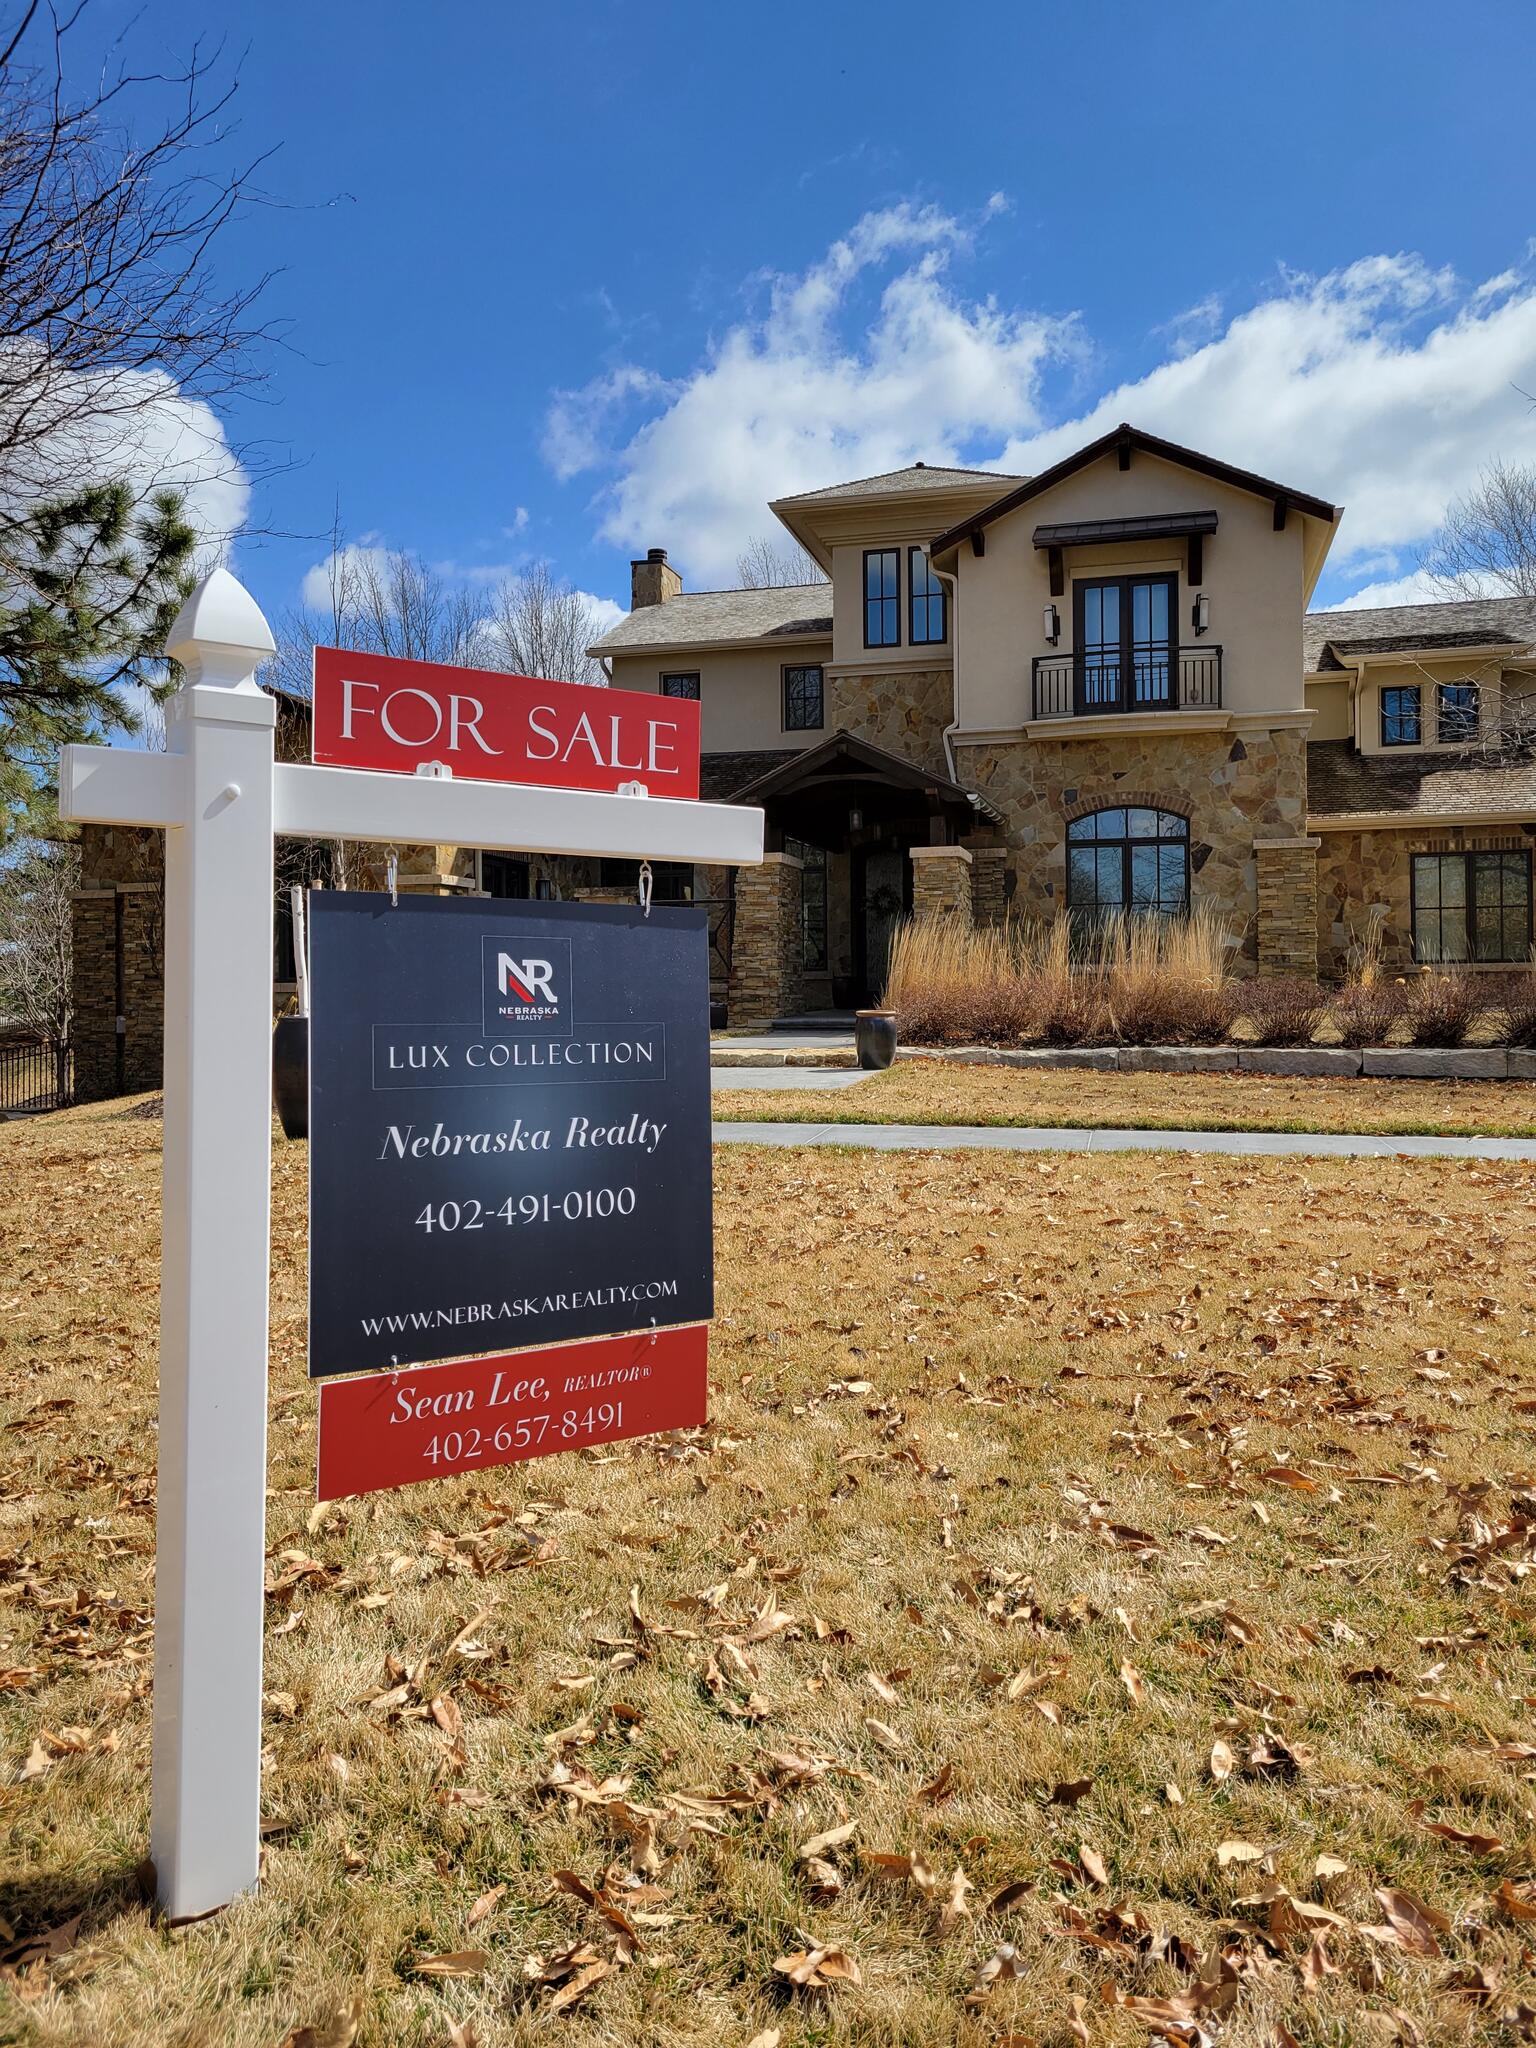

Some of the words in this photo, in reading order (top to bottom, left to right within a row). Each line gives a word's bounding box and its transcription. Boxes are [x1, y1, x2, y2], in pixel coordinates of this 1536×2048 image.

[338, 679, 504, 756] FOR
[525, 705, 680, 775] SALE
[497, 952, 558, 1004] NR
[498, 1006, 559, 1015] NEBRASKA
[388, 1045, 450, 1070] LUX
[465, 1042, 654, 1068] COLLECTION
[376, 1119, 551, 1161] Nebraska
[562, 1113, 667, 1154] Realty
[414, 1186, 637, 1234] 402-491-0100
[360, 1279, 679, 1338] WWW.NEBRASKAREALTY.COM
[389, 1385, 476, 1425] Sean
[484, 1371, 551, 1409] Lee,
[422, 1401, 624, 1466] 402-657-8491
